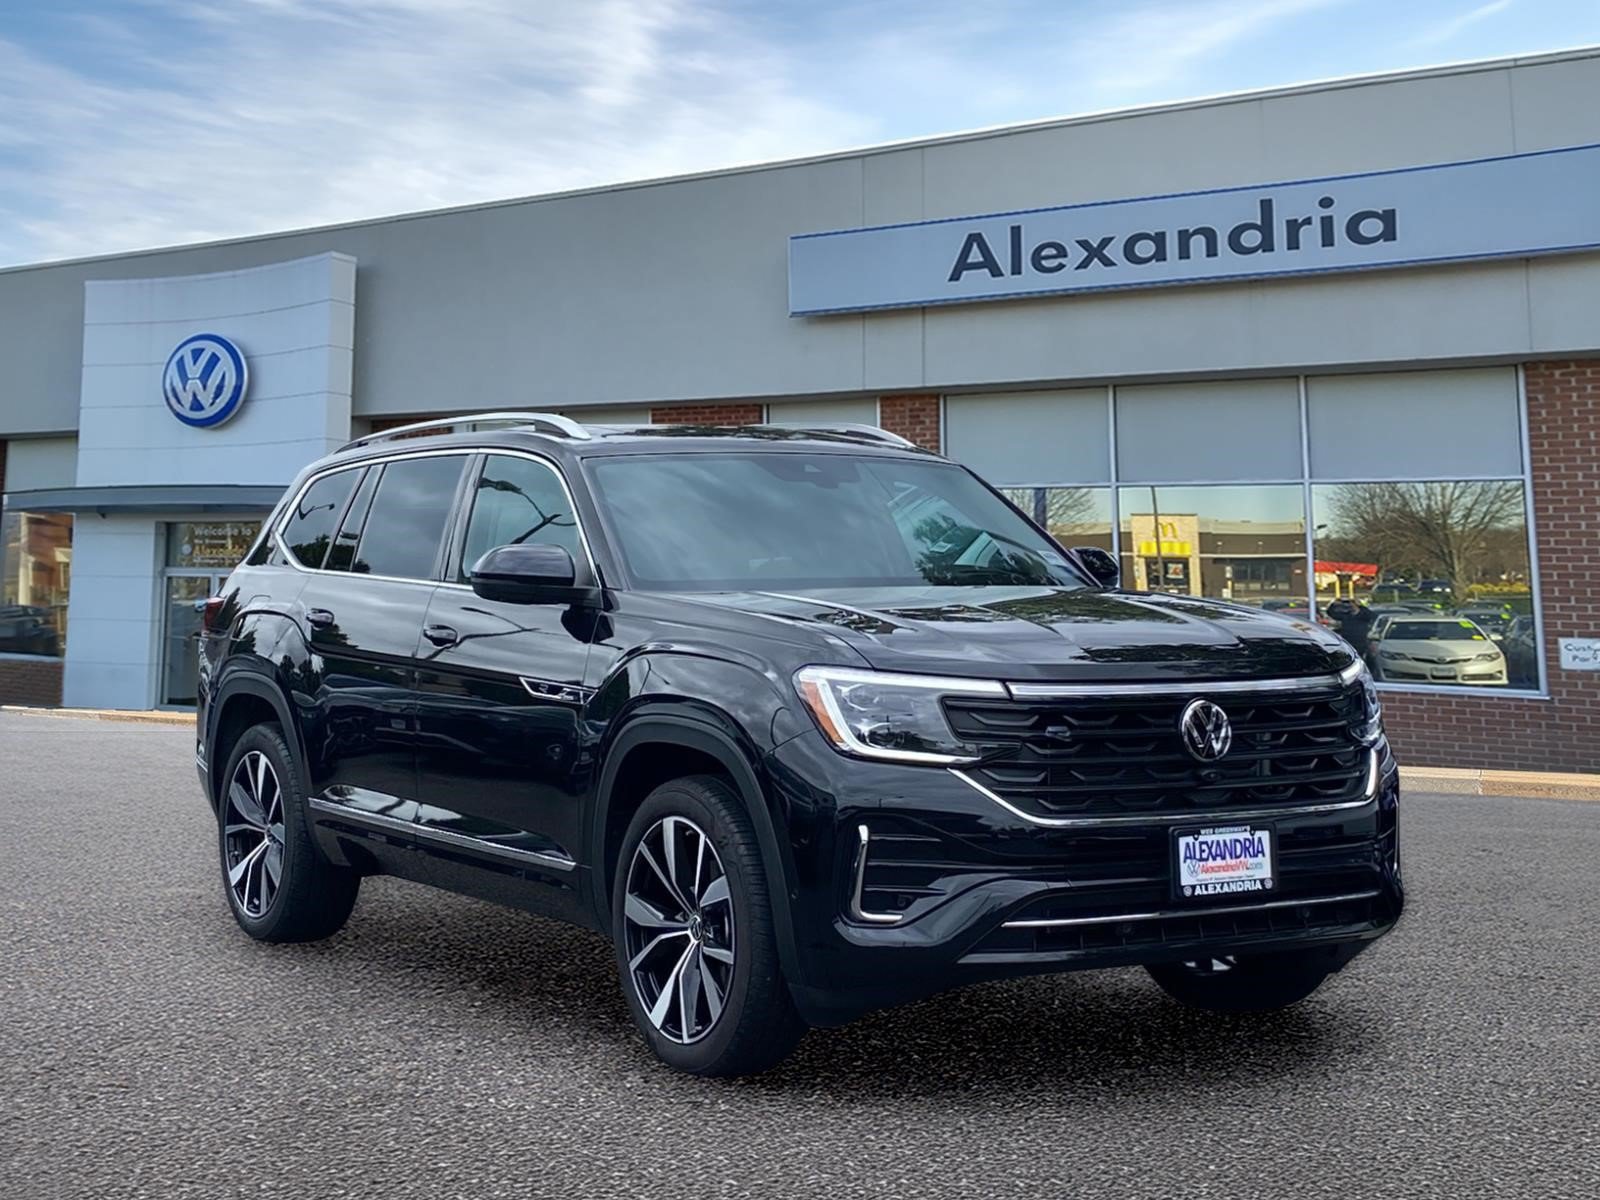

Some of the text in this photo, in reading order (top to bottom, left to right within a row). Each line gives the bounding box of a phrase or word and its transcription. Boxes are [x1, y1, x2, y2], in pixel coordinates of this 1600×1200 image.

[947, 196, 1397, 282] Alexandria
[1183, 837, 1266, 863] ALEXANDRIA
[1194, 880, 1263, 896] ALEXANDRIA
